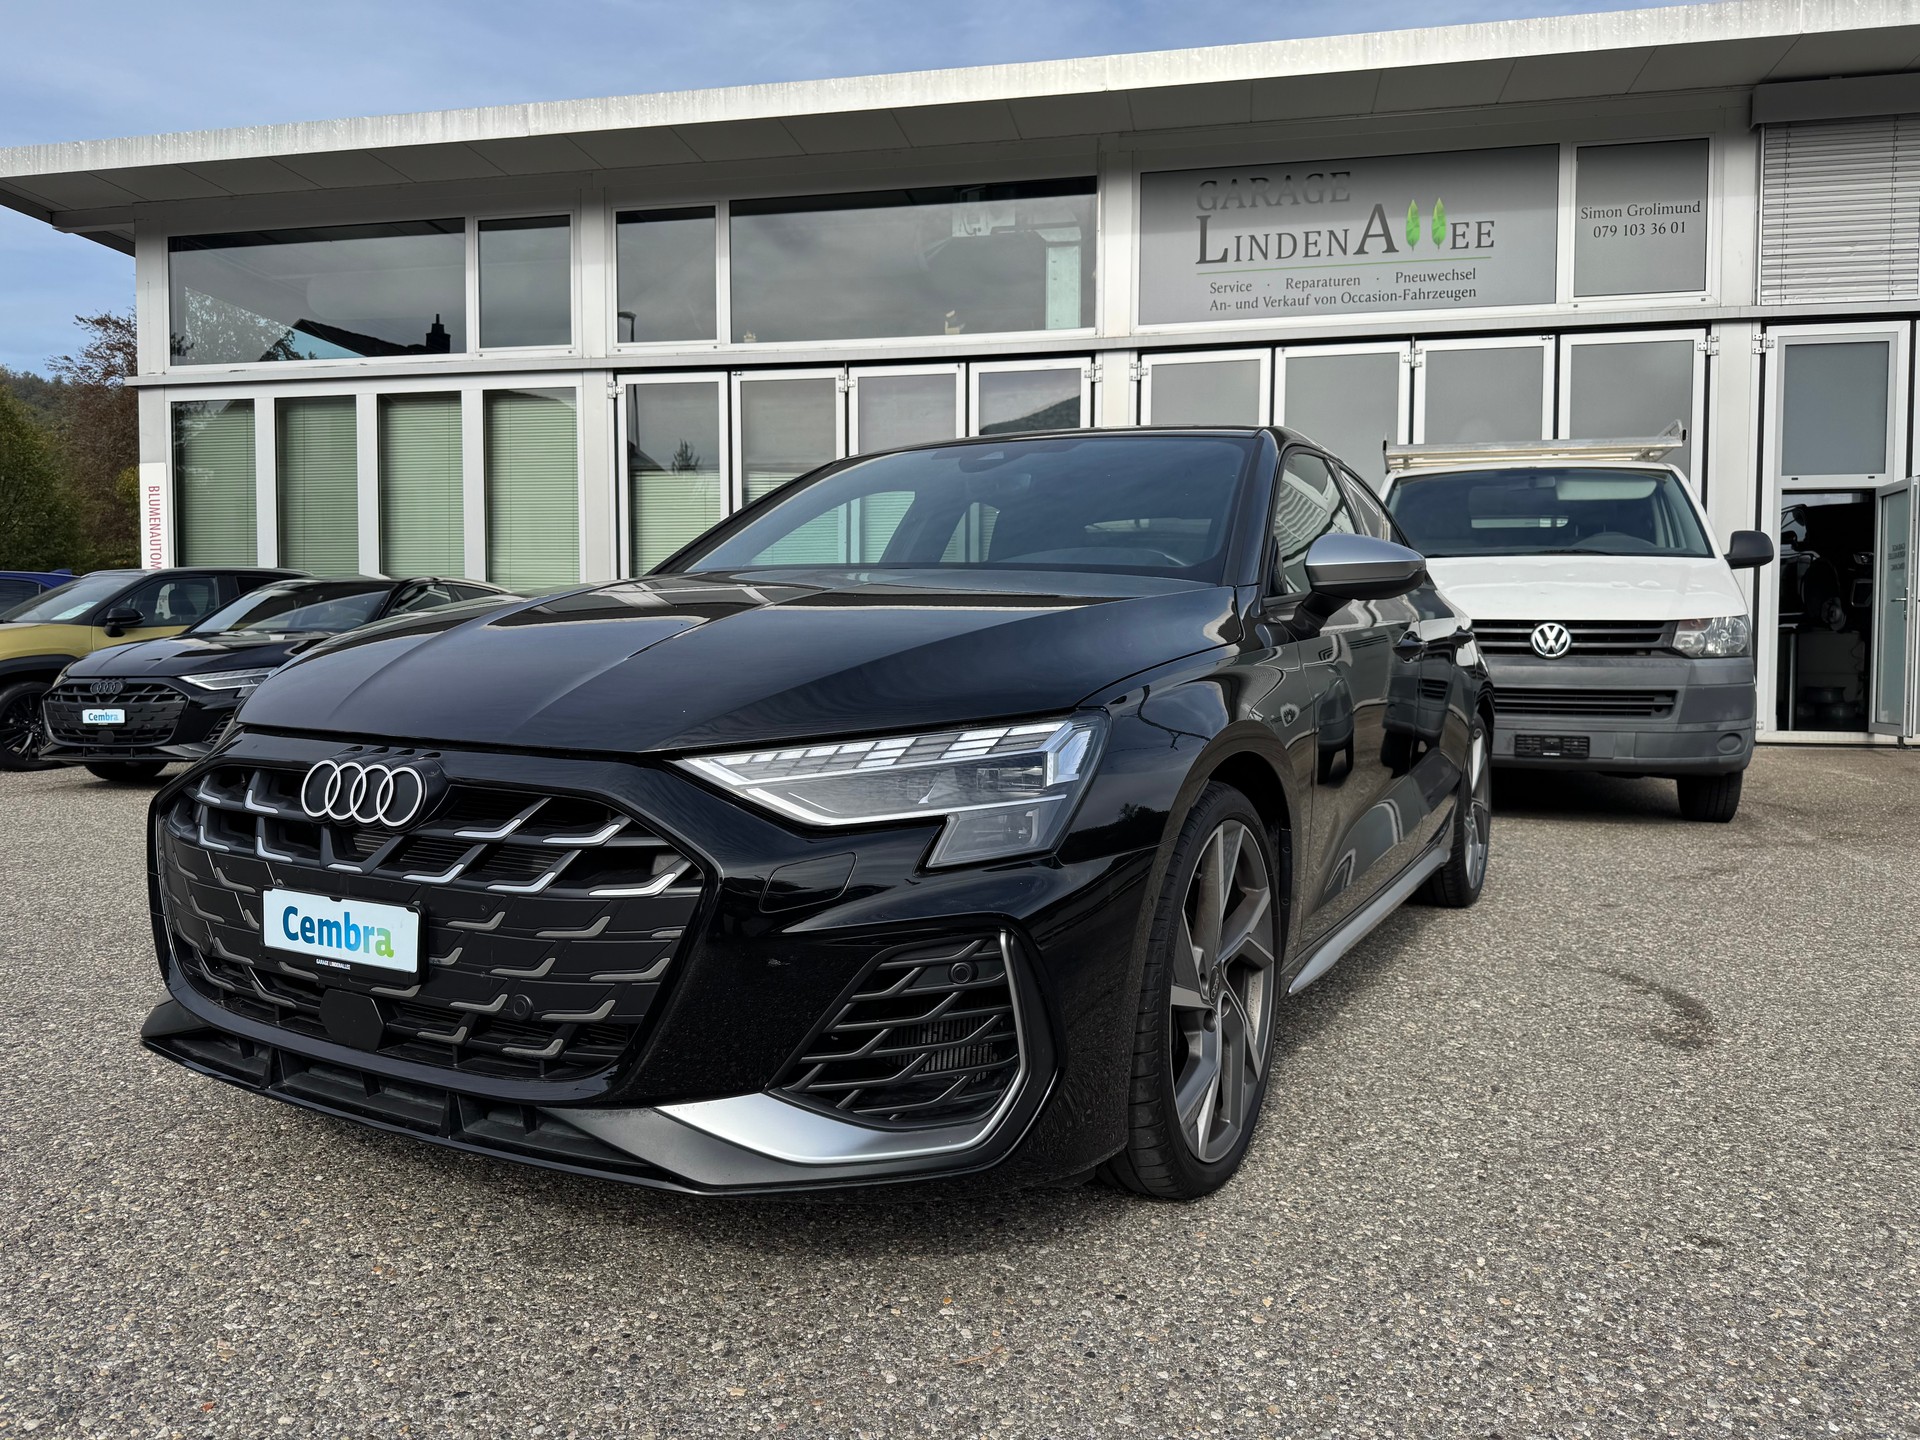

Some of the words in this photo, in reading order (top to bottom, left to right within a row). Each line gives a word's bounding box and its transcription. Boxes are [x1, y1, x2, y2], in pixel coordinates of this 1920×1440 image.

[1196, 171, 1351, 211] GARAGE
[1580, 206, 1622, 220] Simon
[1626, 200, 1701, 217] Grolimund
[1593, 224, 1618, 238] 079
[1623, 223, 1646, 237] 103
[1650, 222, 1667, 235] 36
[1670, 221, 1686, 234] 01
[1209, 281, 1253, 294] Service
[1285, 275, 1361, 292] Reparaturen
[1395, 267, 1476, 284] Pneuwechsel
[1209, 298, 1231, 311] An-
[1235, 296, 1259, 310] und
[1262, 294, 1311, 308] Verkauf
[1314, 295, 1337, 306] von
[1340, 286, 1477, 304] Occasion-Fahrzeugen
[88, 712, 119, 721] Cembra
[283, 906, 395, 958] Cembra
